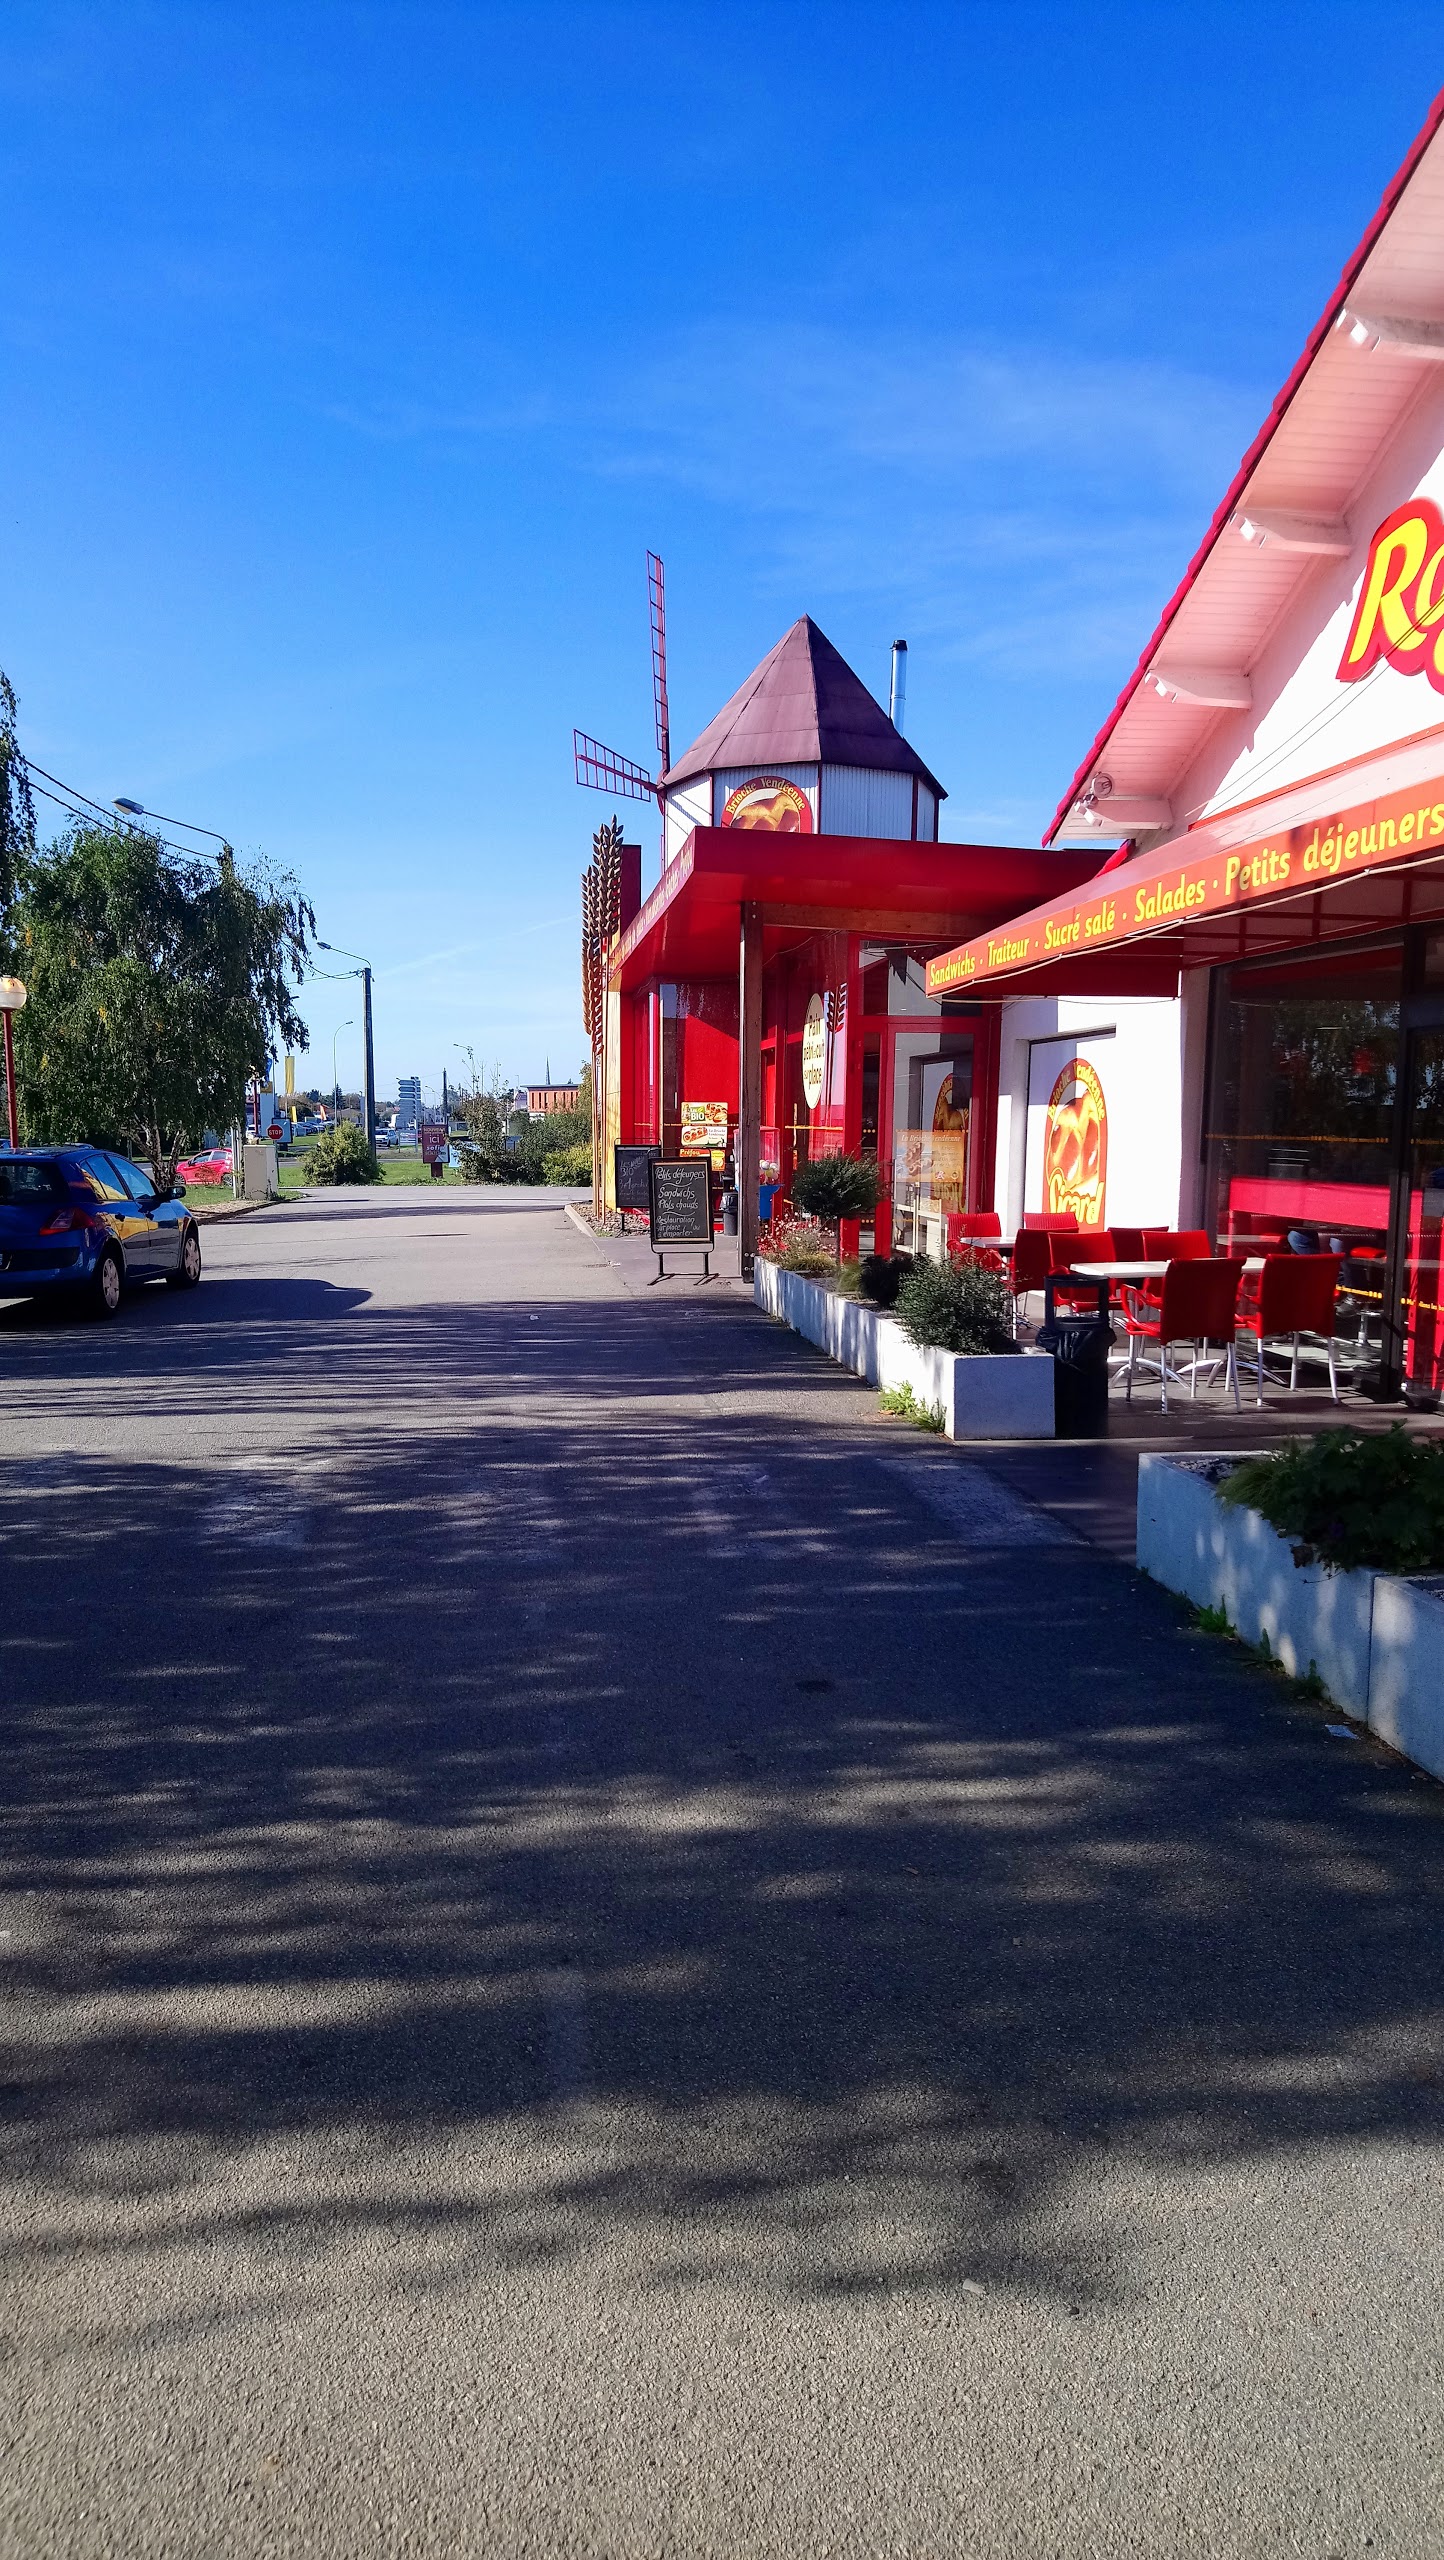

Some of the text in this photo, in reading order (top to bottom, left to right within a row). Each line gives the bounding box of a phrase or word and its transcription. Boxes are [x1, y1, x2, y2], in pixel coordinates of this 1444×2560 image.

[725, 778, 806, 814] Brioche Vendéenne
[929, 803, 1444, 987] Sandwichs Traiteur Sucré salé Salades Petits déjeuners
[808, 1013, 821, 1037] Pain
[808, 1063, 822, 1090] place
[1047, 1061, 1106, 1121] Brioche Vendéenne
[690, 1112, 705, 1120] BIO
[268, 1128, 282, 1136] STOP
[680, 1149, 700, 1157] Préfou
[672, 1166, 705, 1184] déjeuners
[658, 1186, 695, 1200] Sandwichs
[1049, 1172, 1105, 1225] Sicard
[658, 1199, 699, 1210] Plats chauds
